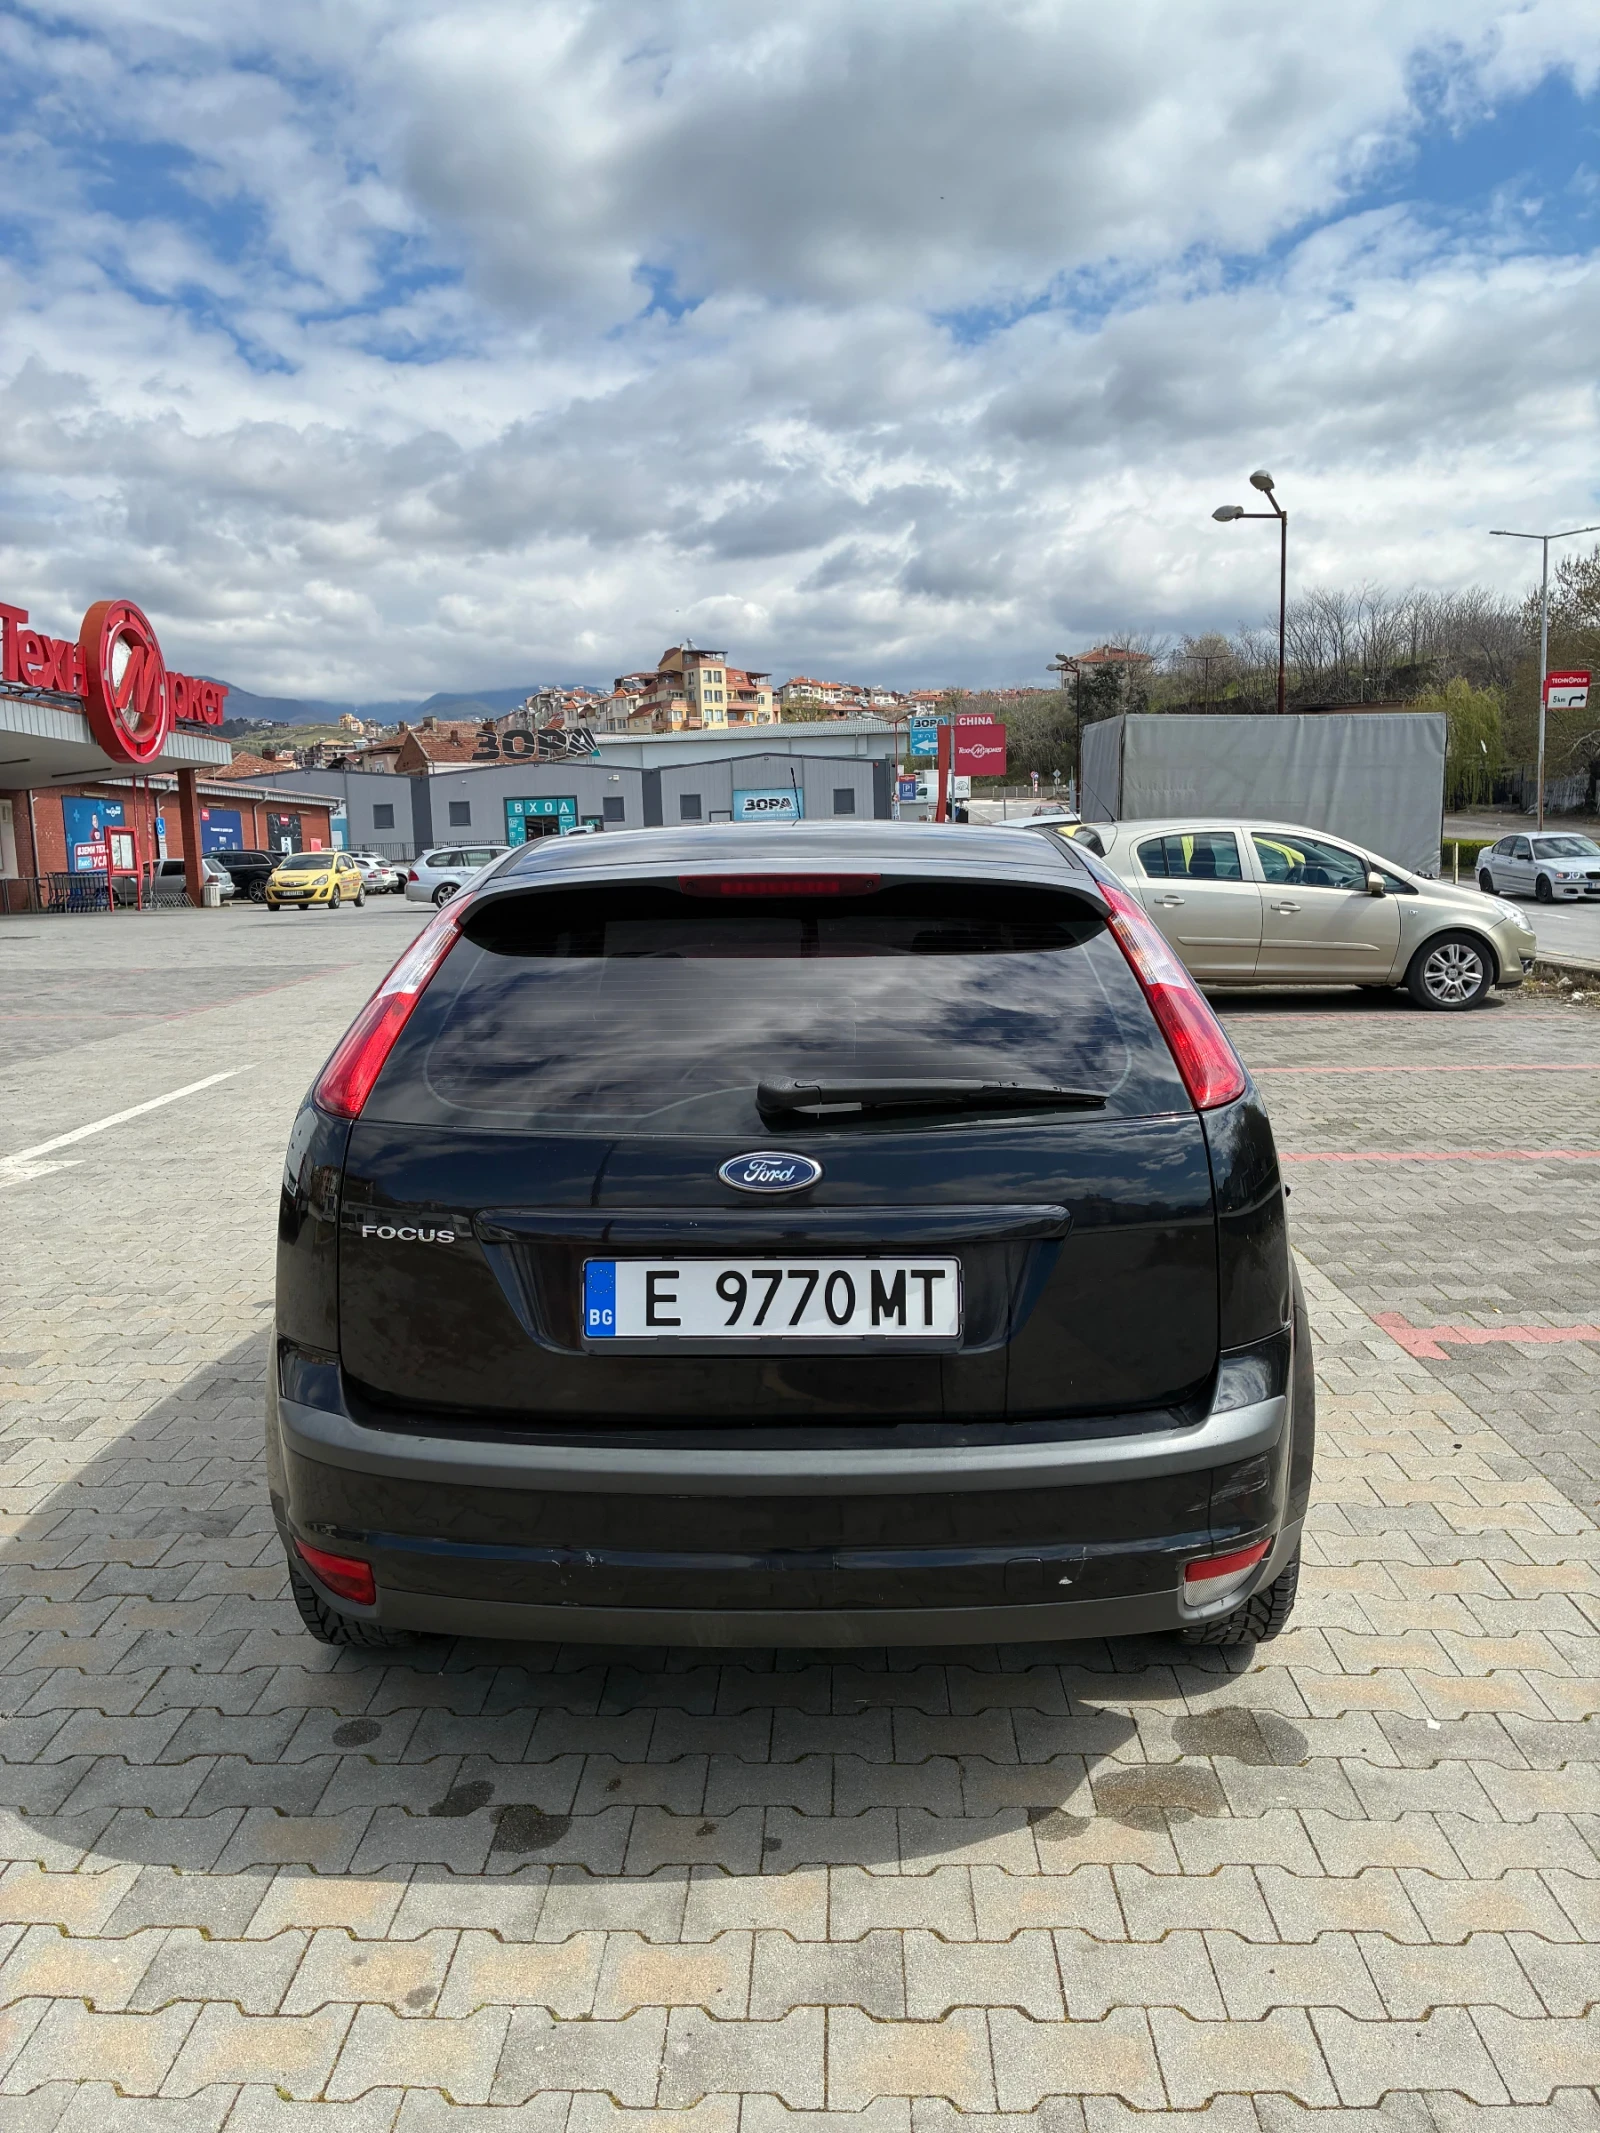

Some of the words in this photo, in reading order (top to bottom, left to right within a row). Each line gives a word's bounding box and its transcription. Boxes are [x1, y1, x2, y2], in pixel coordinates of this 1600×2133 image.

[958, 716, 993, 726] CHINA
[471, 727, 602, 760] ЗОРА
[514, 801, 570, 814] ВХОД
[743, 797, 794, 811] ЗОРА
[96, 844, 106, 853] ТЕХ
[93, 856, 107, 867] УСЛ
[743, 1160, 795, 1183] Ford
[361, 1225, 455, 1243] FOCUS
[645, 1270, 681, 1326] E
[715, 1270, 856, 1326] 9770
[870, 1269, 945, 1326] MT
[589, 1309, 613, 1326] BG
